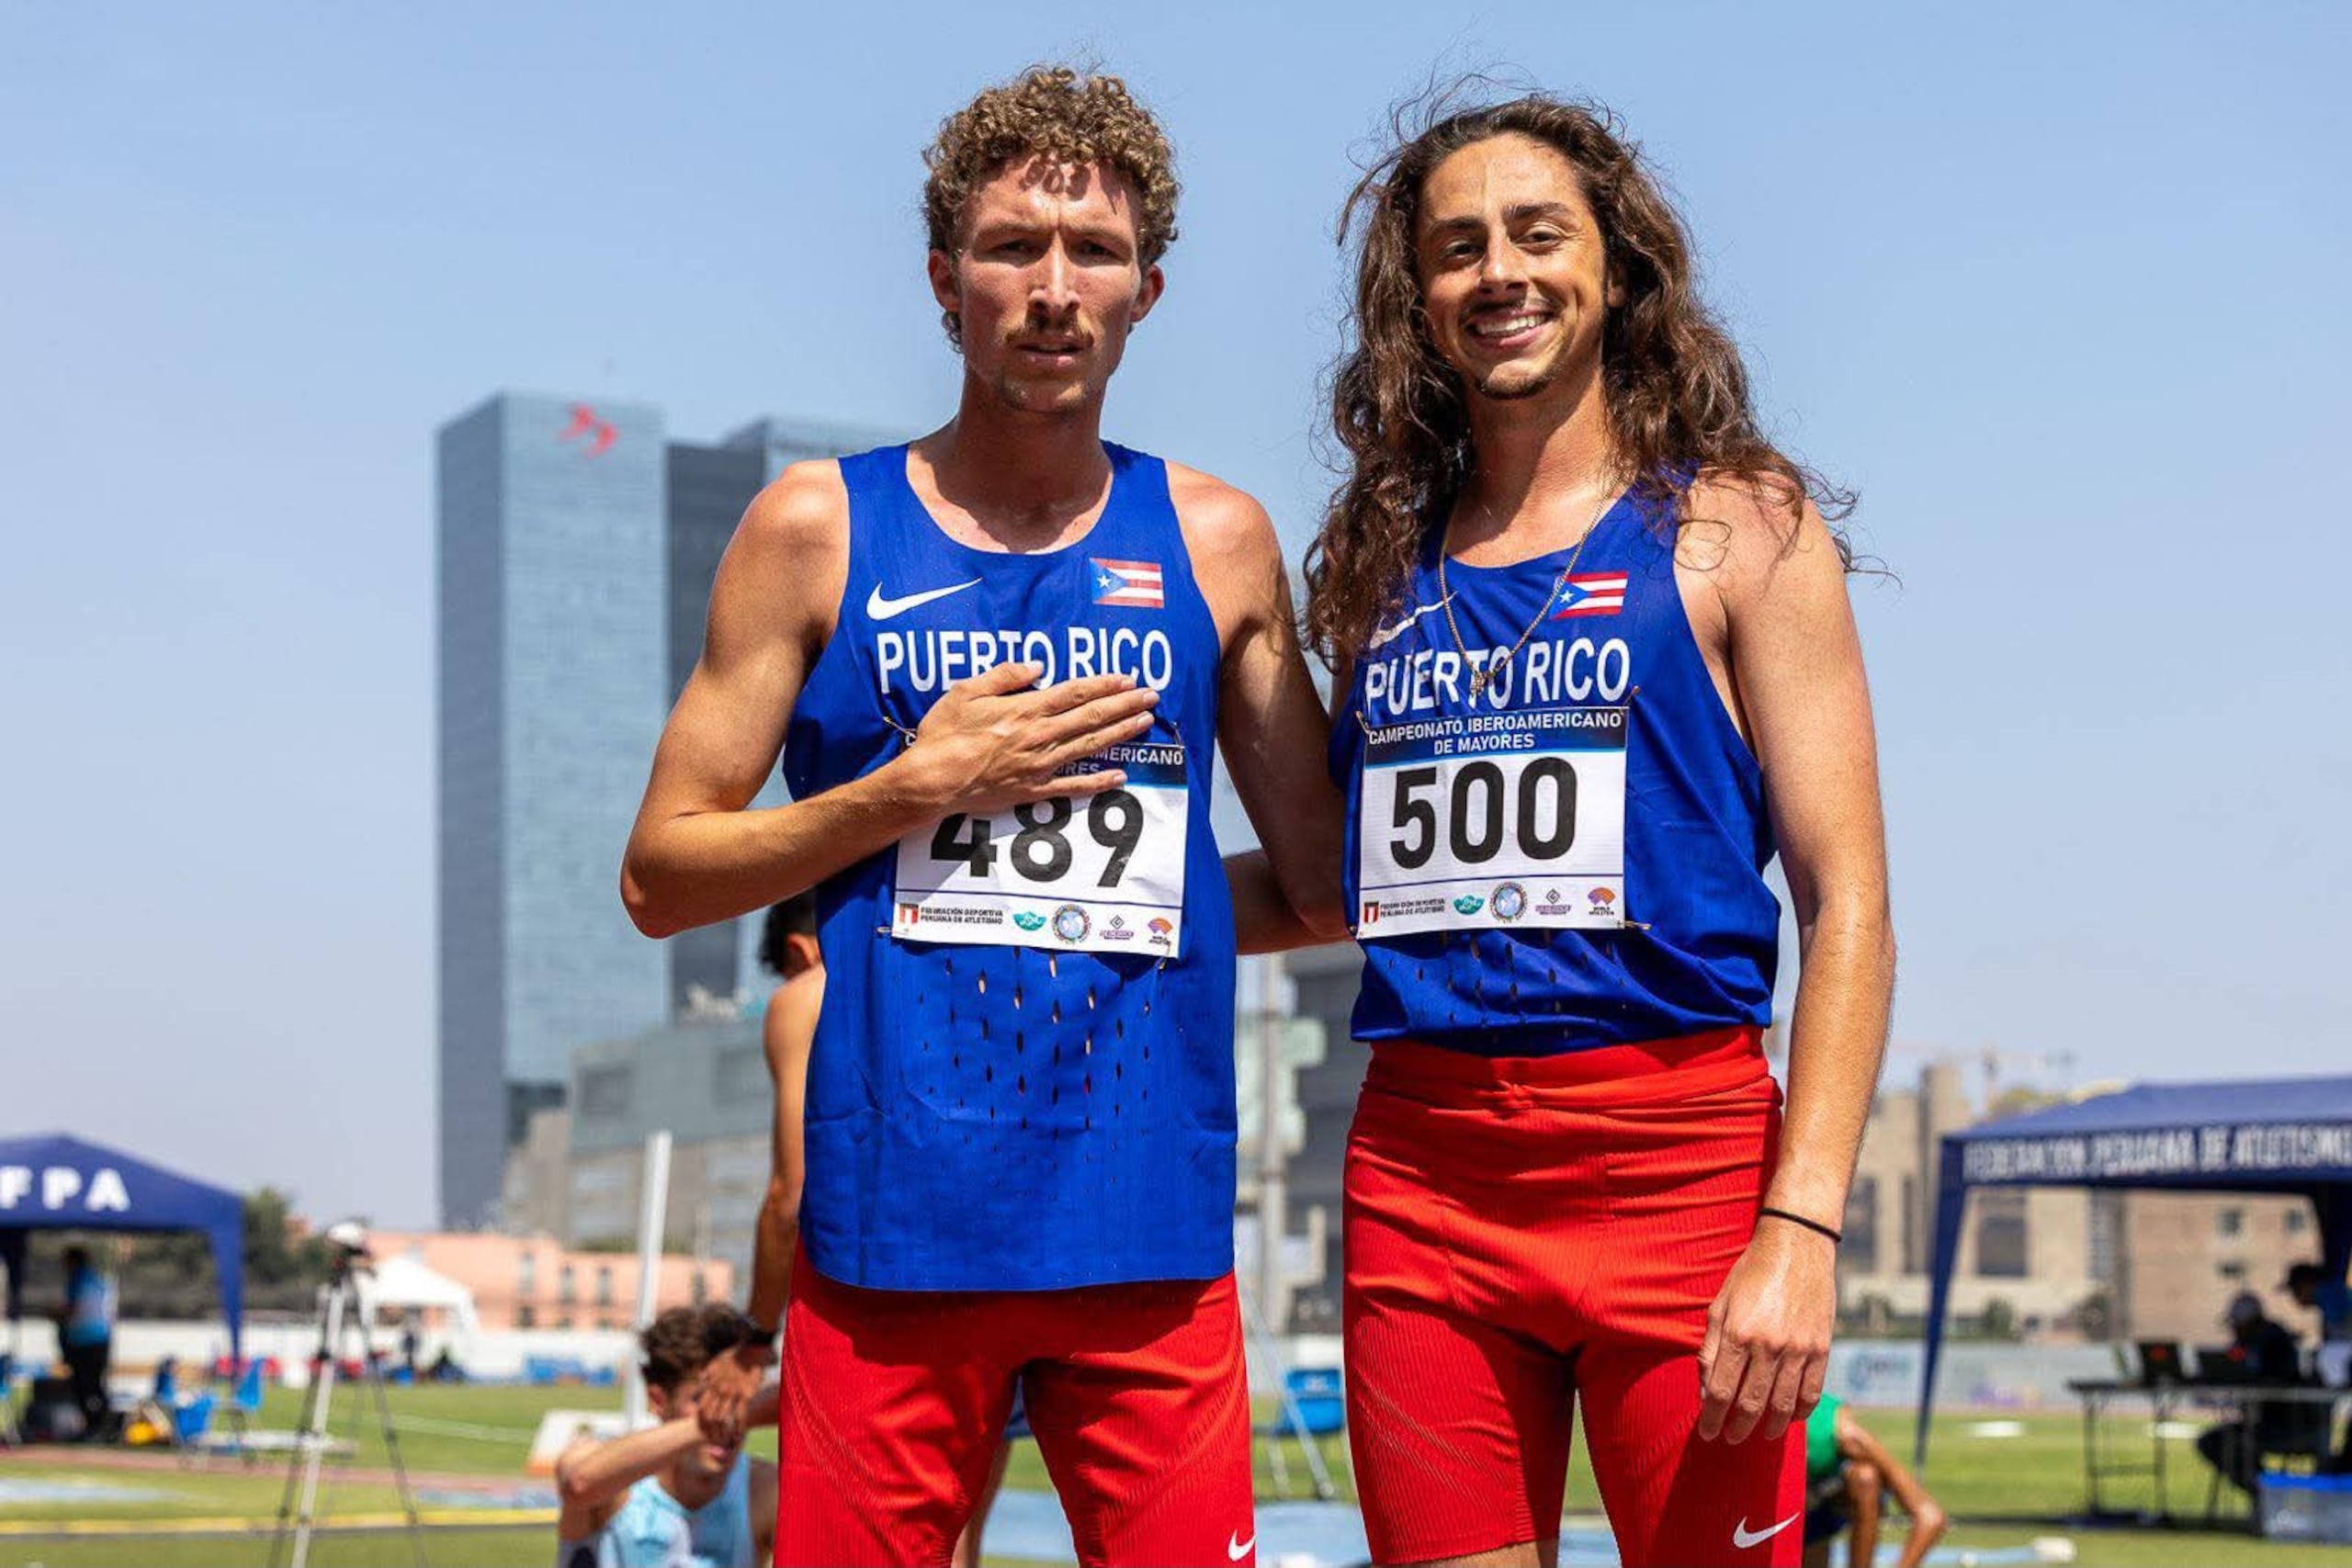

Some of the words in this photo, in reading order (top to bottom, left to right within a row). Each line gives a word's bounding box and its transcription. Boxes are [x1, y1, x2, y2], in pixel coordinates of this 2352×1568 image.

[876, 630, 1056, 694] PUERTO
[1068, 626, 1172, 691] RICO
[1365, 645, 1514, 717] PUERTO
[1524, 637, 1631, 704] RICO
[1369, 720, 1463, 745] CAMPEONATO
[1467, 713, 1623, 733] IBEROAMERICANO
[1433, 739, 1453, 755] DE
[1457, 733, 1534, 751] MAYORES
[931, 788, 1145, 888] 489
[1390, 756, 1577, 869] 500
